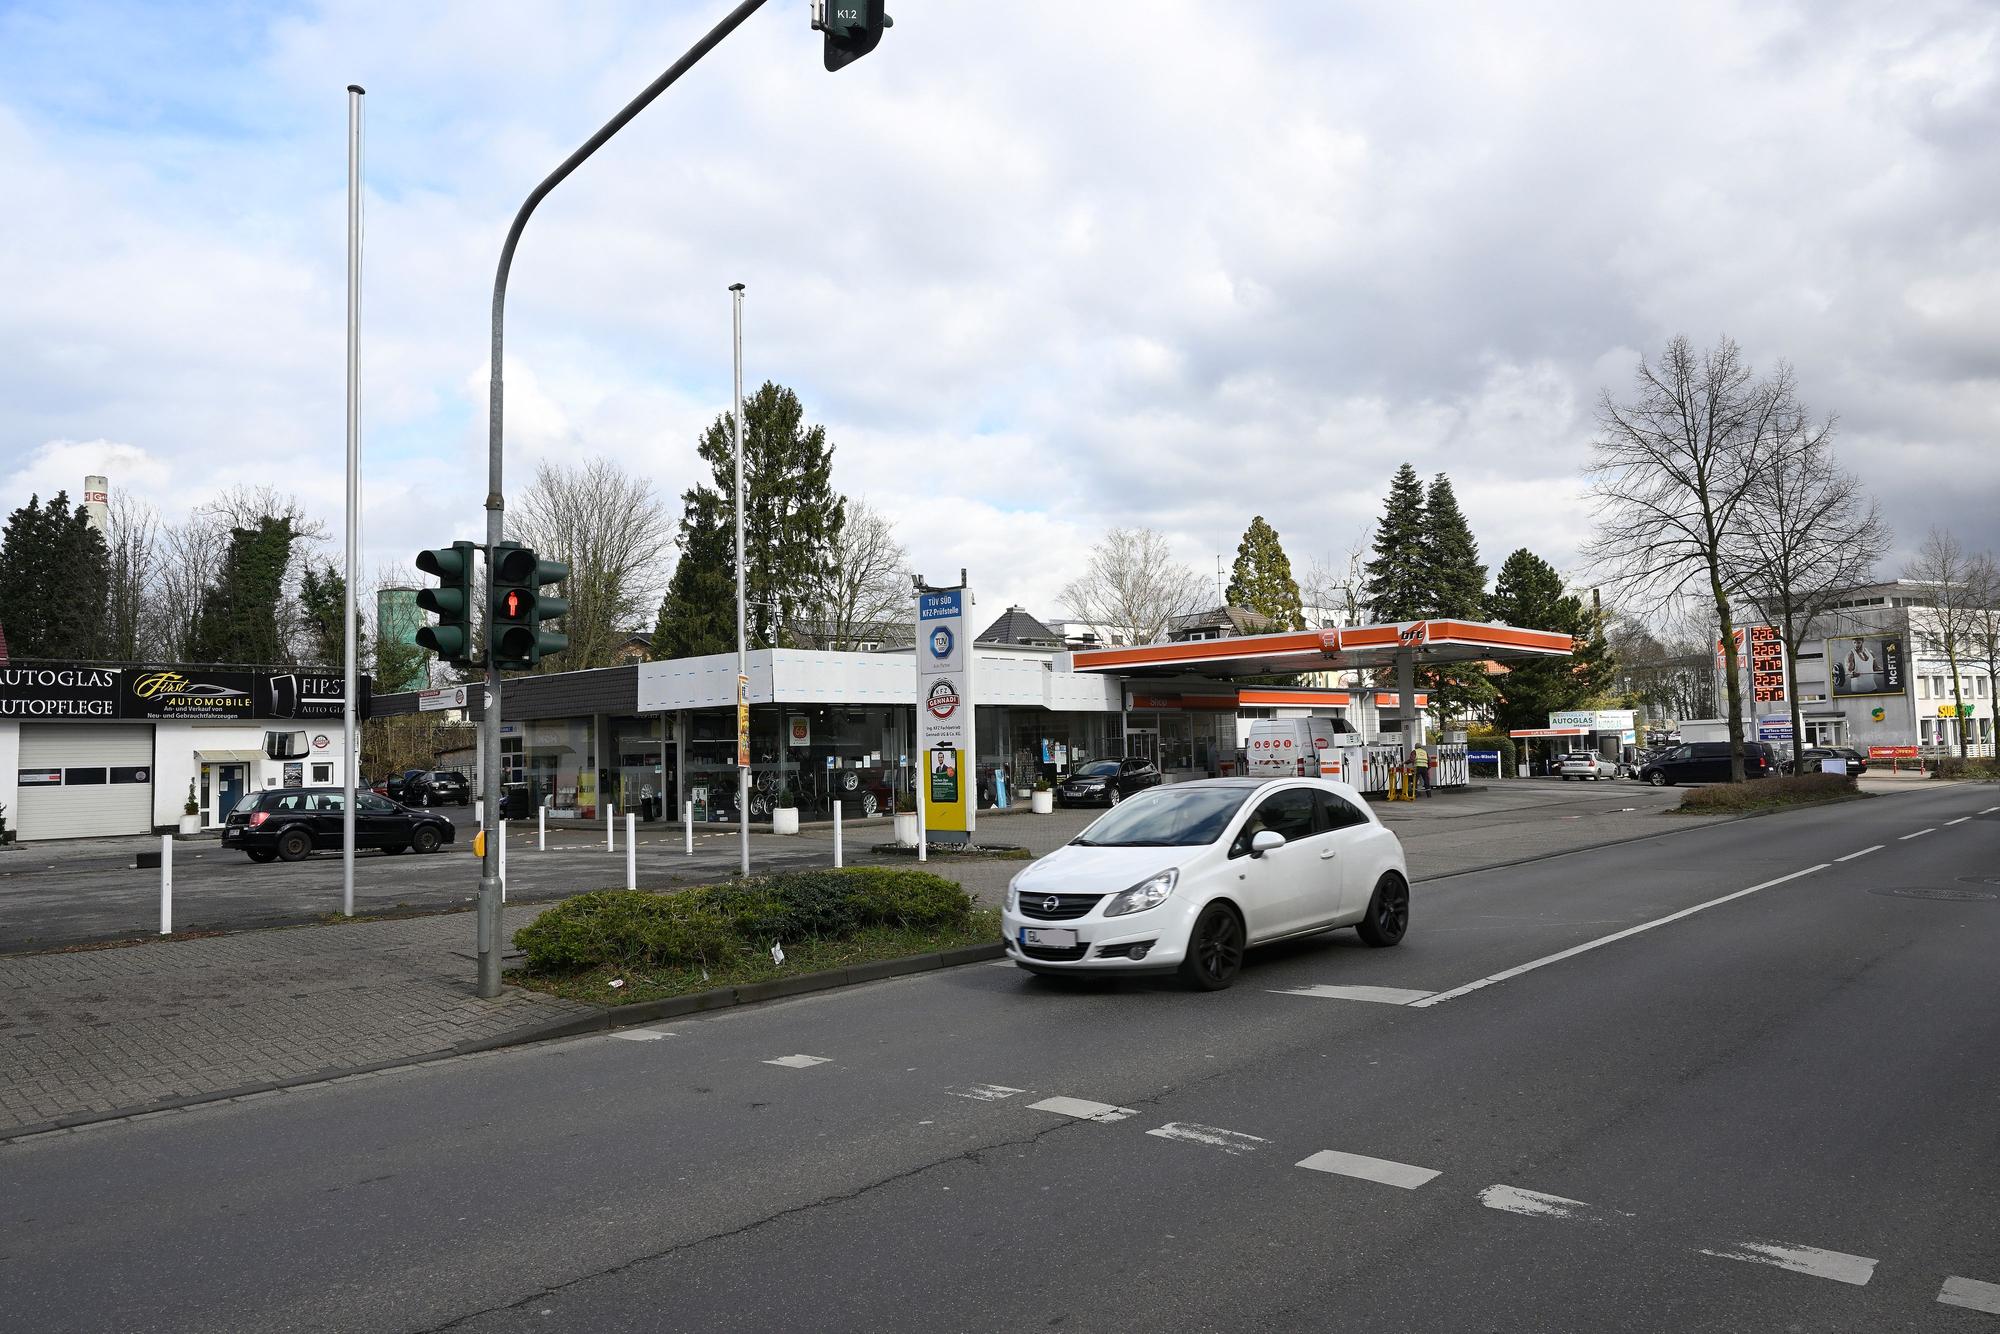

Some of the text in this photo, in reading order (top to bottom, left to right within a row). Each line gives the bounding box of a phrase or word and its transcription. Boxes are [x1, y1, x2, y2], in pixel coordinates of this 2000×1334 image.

[837, 9, 857, 19] K1.2
[928, 596, 952, 606] TÜV SÜD
[922, 606, 958, 617] KFZ-Prüfstelle
[1401, 630, 1423, 640] bft
[936, 638, 948, 646] TÜV
[138, 672, 190, 698] First
[930, 696, 956, 706] GENNADI
[0, 699, 113, 715] UTOPFLEGE
[795, 728, 804, 736] 66
